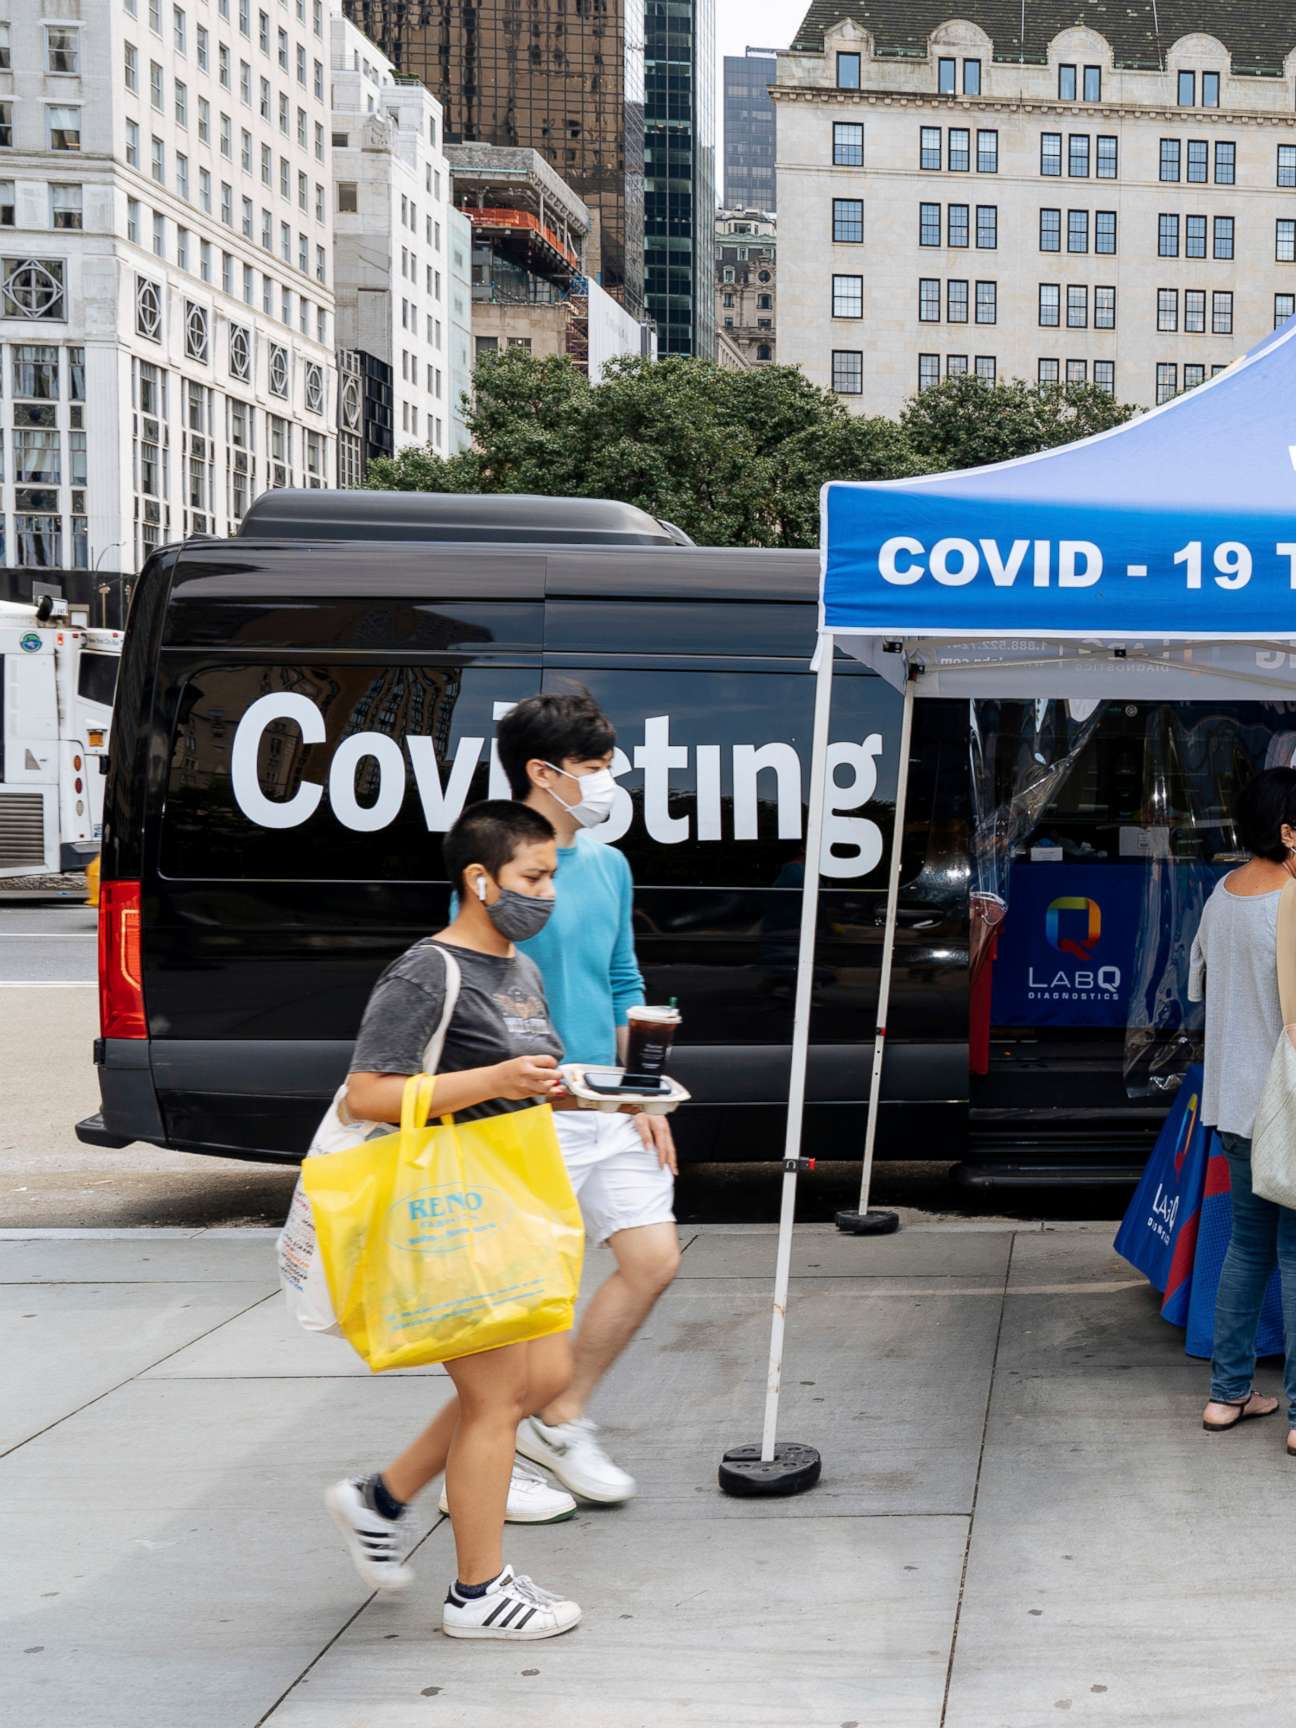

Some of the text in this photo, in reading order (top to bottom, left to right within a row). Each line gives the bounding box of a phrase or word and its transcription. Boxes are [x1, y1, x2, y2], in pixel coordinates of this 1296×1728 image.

[878, 536, 1103, 588] COVID
[1127, 564, 1147, 577] -
[1173, 541, 1253, 590] 19
[1027, 965, 1121, 992] LABQ
[1027, 991, 1120, 1000] DIAGNOSTICS
[408, 1191, 484, 1221] RENO
